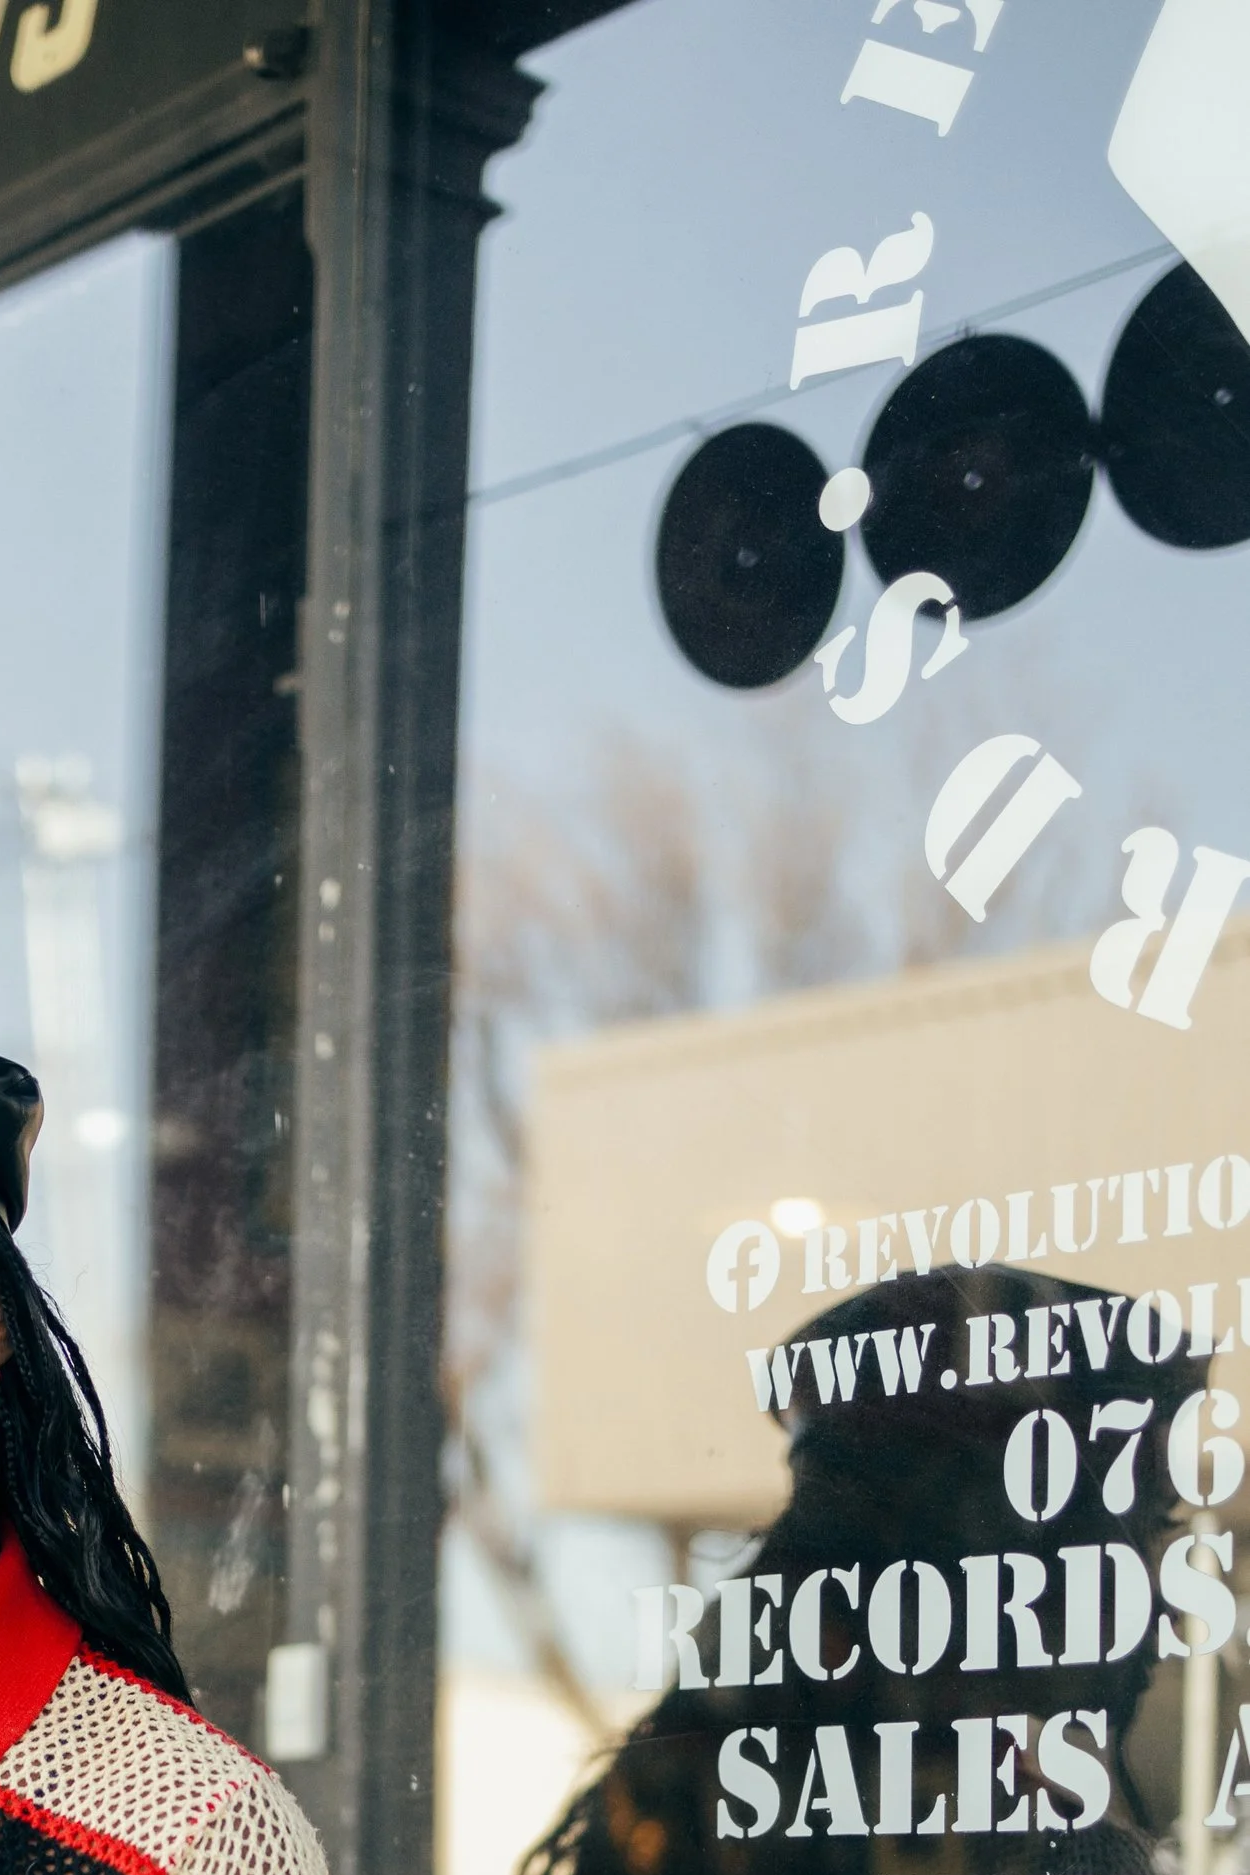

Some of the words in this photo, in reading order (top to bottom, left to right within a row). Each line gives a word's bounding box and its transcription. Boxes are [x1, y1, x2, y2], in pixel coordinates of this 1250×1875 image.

[801, 1153, 1250, 1294] REVOLUTIO
[745, 1277, 1250, 1413] WWW.REVOL
[1004, 1388, 1246, 1523] 076
[632, 1532, 1250, 1691] RECORDS
[716, 1709, 1111, 1840] SALES
